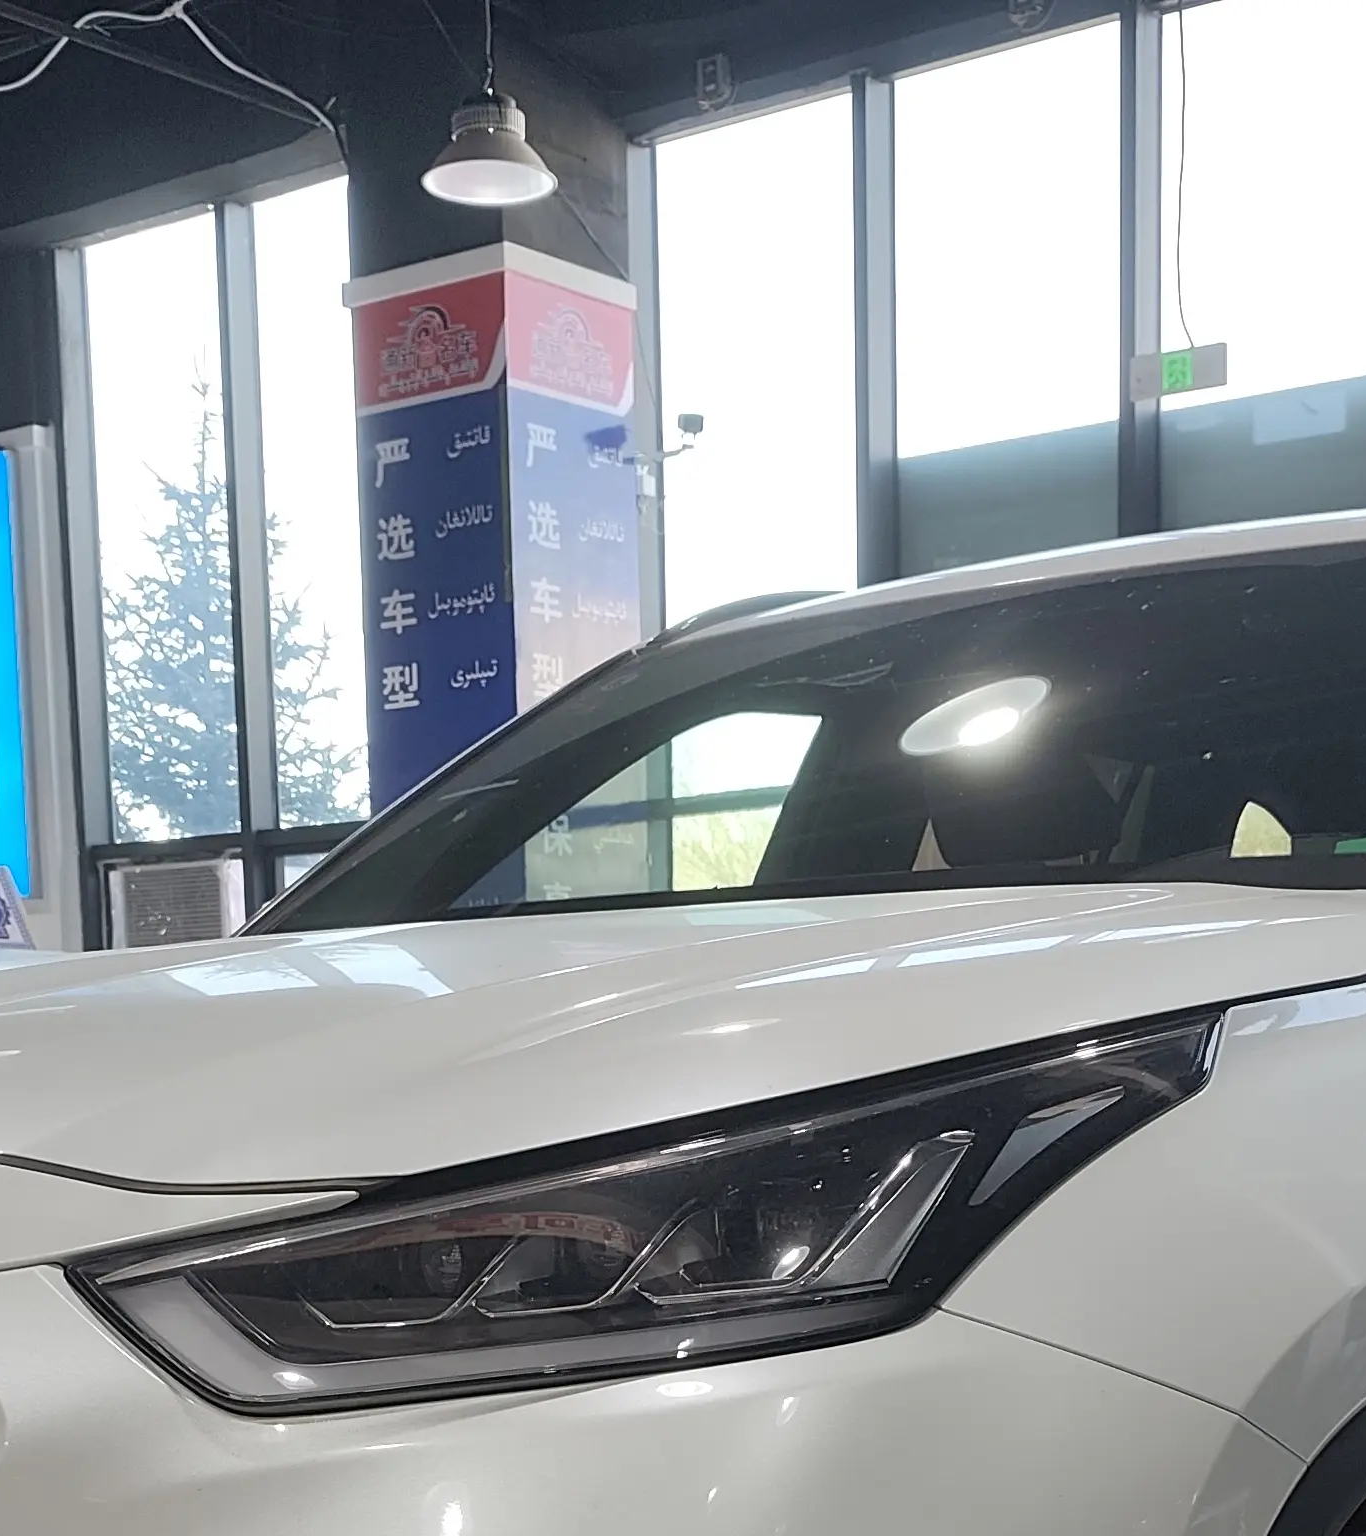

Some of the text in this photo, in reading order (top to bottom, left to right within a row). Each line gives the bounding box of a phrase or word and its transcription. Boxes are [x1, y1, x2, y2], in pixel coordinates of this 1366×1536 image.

[375, 438, 420, 711] 严选车型
[526, 422, 563, 699] 严选车型
